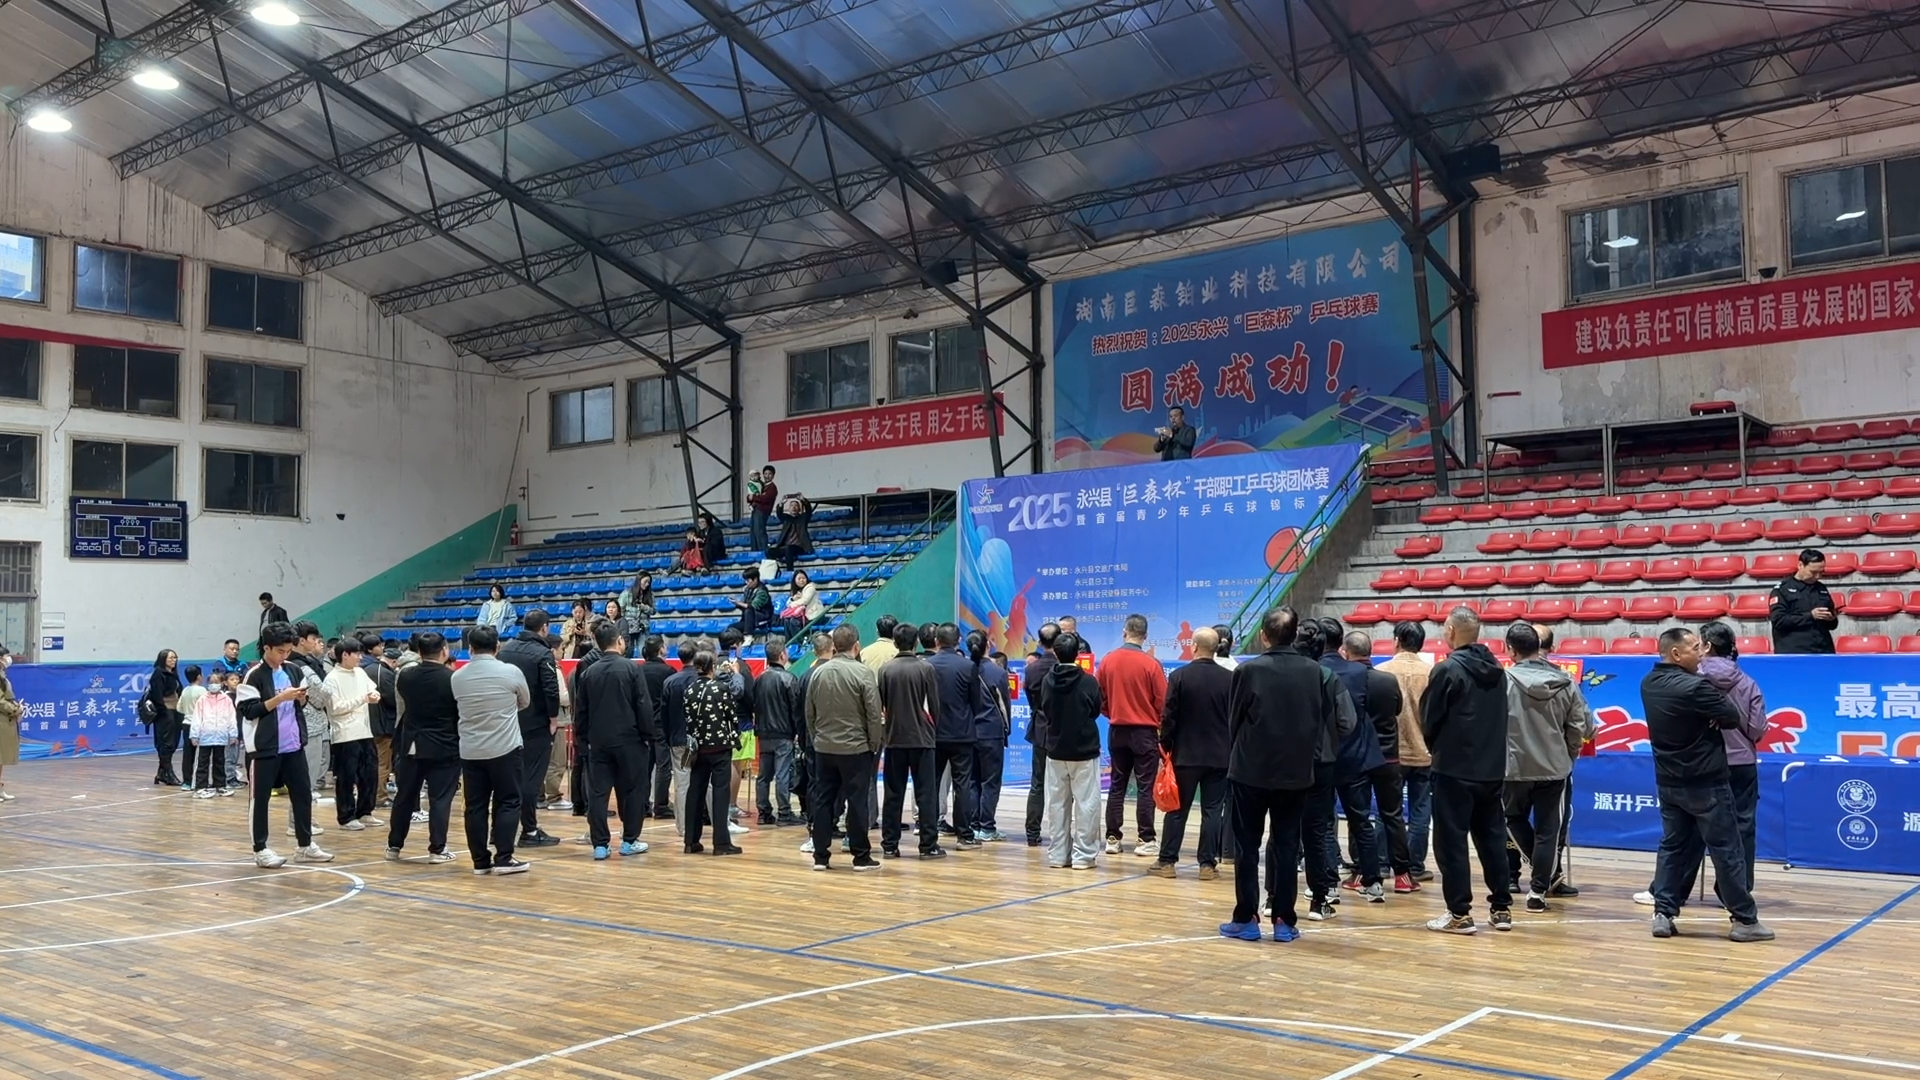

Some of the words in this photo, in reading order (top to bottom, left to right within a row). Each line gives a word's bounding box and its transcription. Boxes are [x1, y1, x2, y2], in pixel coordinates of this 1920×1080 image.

[1575, 276, 1920, 356] 建设负责任可信赖高质量发展的国家
[1120, 339, 1345, 413] 圆满成功！
[786, 418, 865, 453] 中国体育彩票
[867, 411, 923, 443] 来之于民
[926, 404, 986, 436] 用之于民
[1008, 492, 1073, 532] 2025
[1834, 682, 1920, 719] 最高
[1593, 791, 1660, 813] 源升乒
